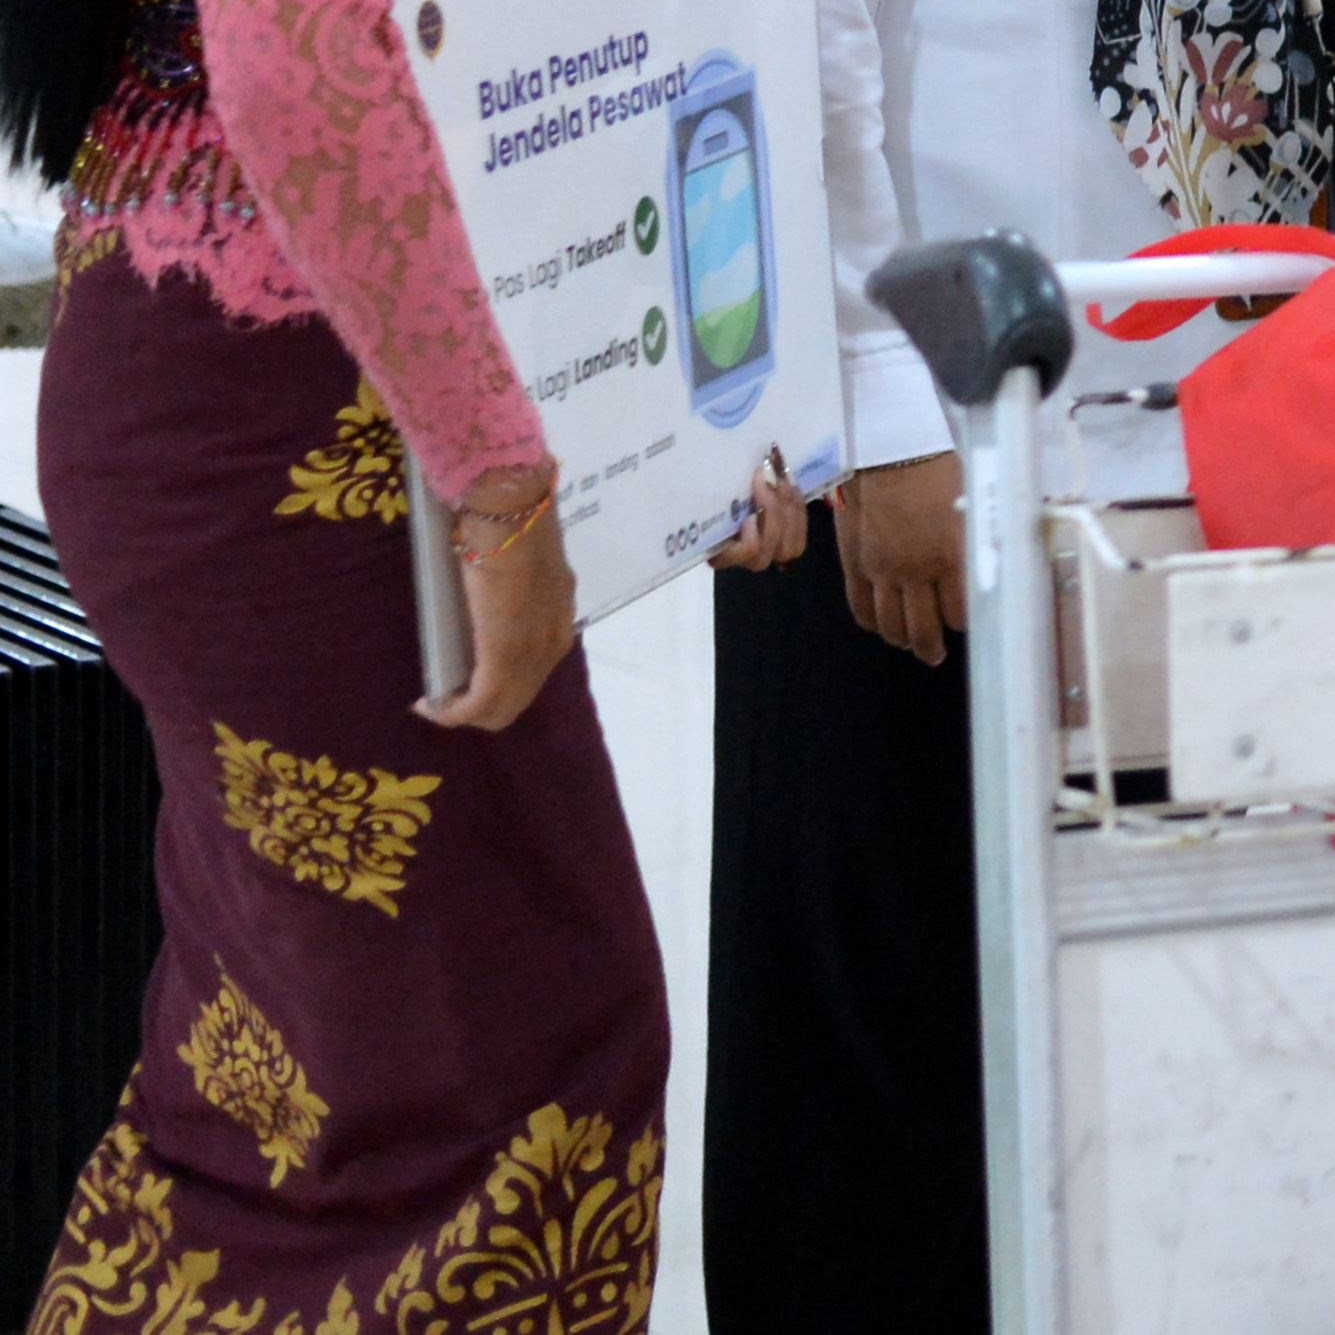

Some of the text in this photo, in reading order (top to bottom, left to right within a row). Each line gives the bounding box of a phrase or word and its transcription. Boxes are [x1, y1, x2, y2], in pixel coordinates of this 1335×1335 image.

[478, 30, 649, 121] Buka Penutup
[484, 61, 688, 173] Jendela Pesawat
[493, 220, 627, 302] Pas Lagi Takeoff
[537, 361, 570, 402] Lagi
[573, 336, 639, 385] Landing
